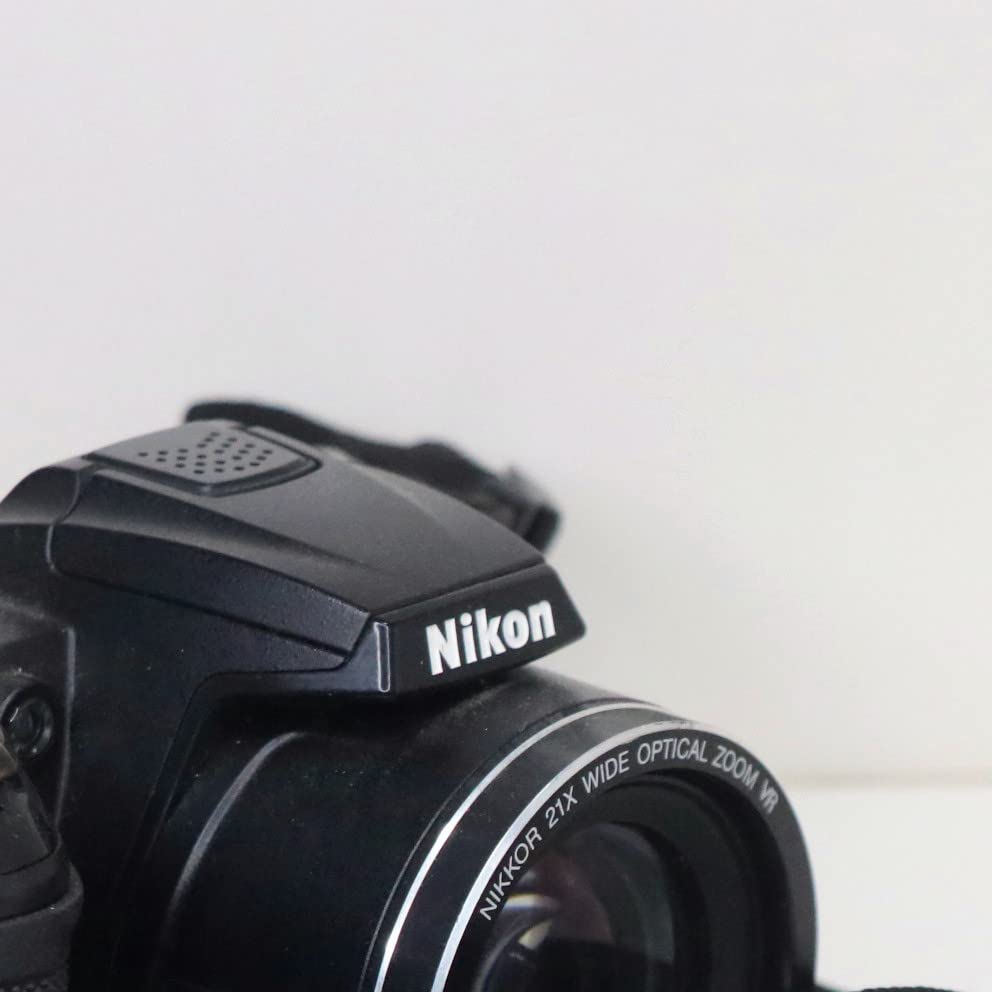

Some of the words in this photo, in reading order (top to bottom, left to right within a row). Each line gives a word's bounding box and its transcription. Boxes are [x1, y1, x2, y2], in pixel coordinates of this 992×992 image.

[426, 599, 556, 676] Nikon
[479, 826, 543, 921] NIKKOR
[545, 785, 578, 830] 21X
[582, 750, 630, 794] WIDE
[637, 737, 709, 765] OPTICAL
[711, 745, 761, 791] ZOOM
[760, 780, 780, 815] VR
